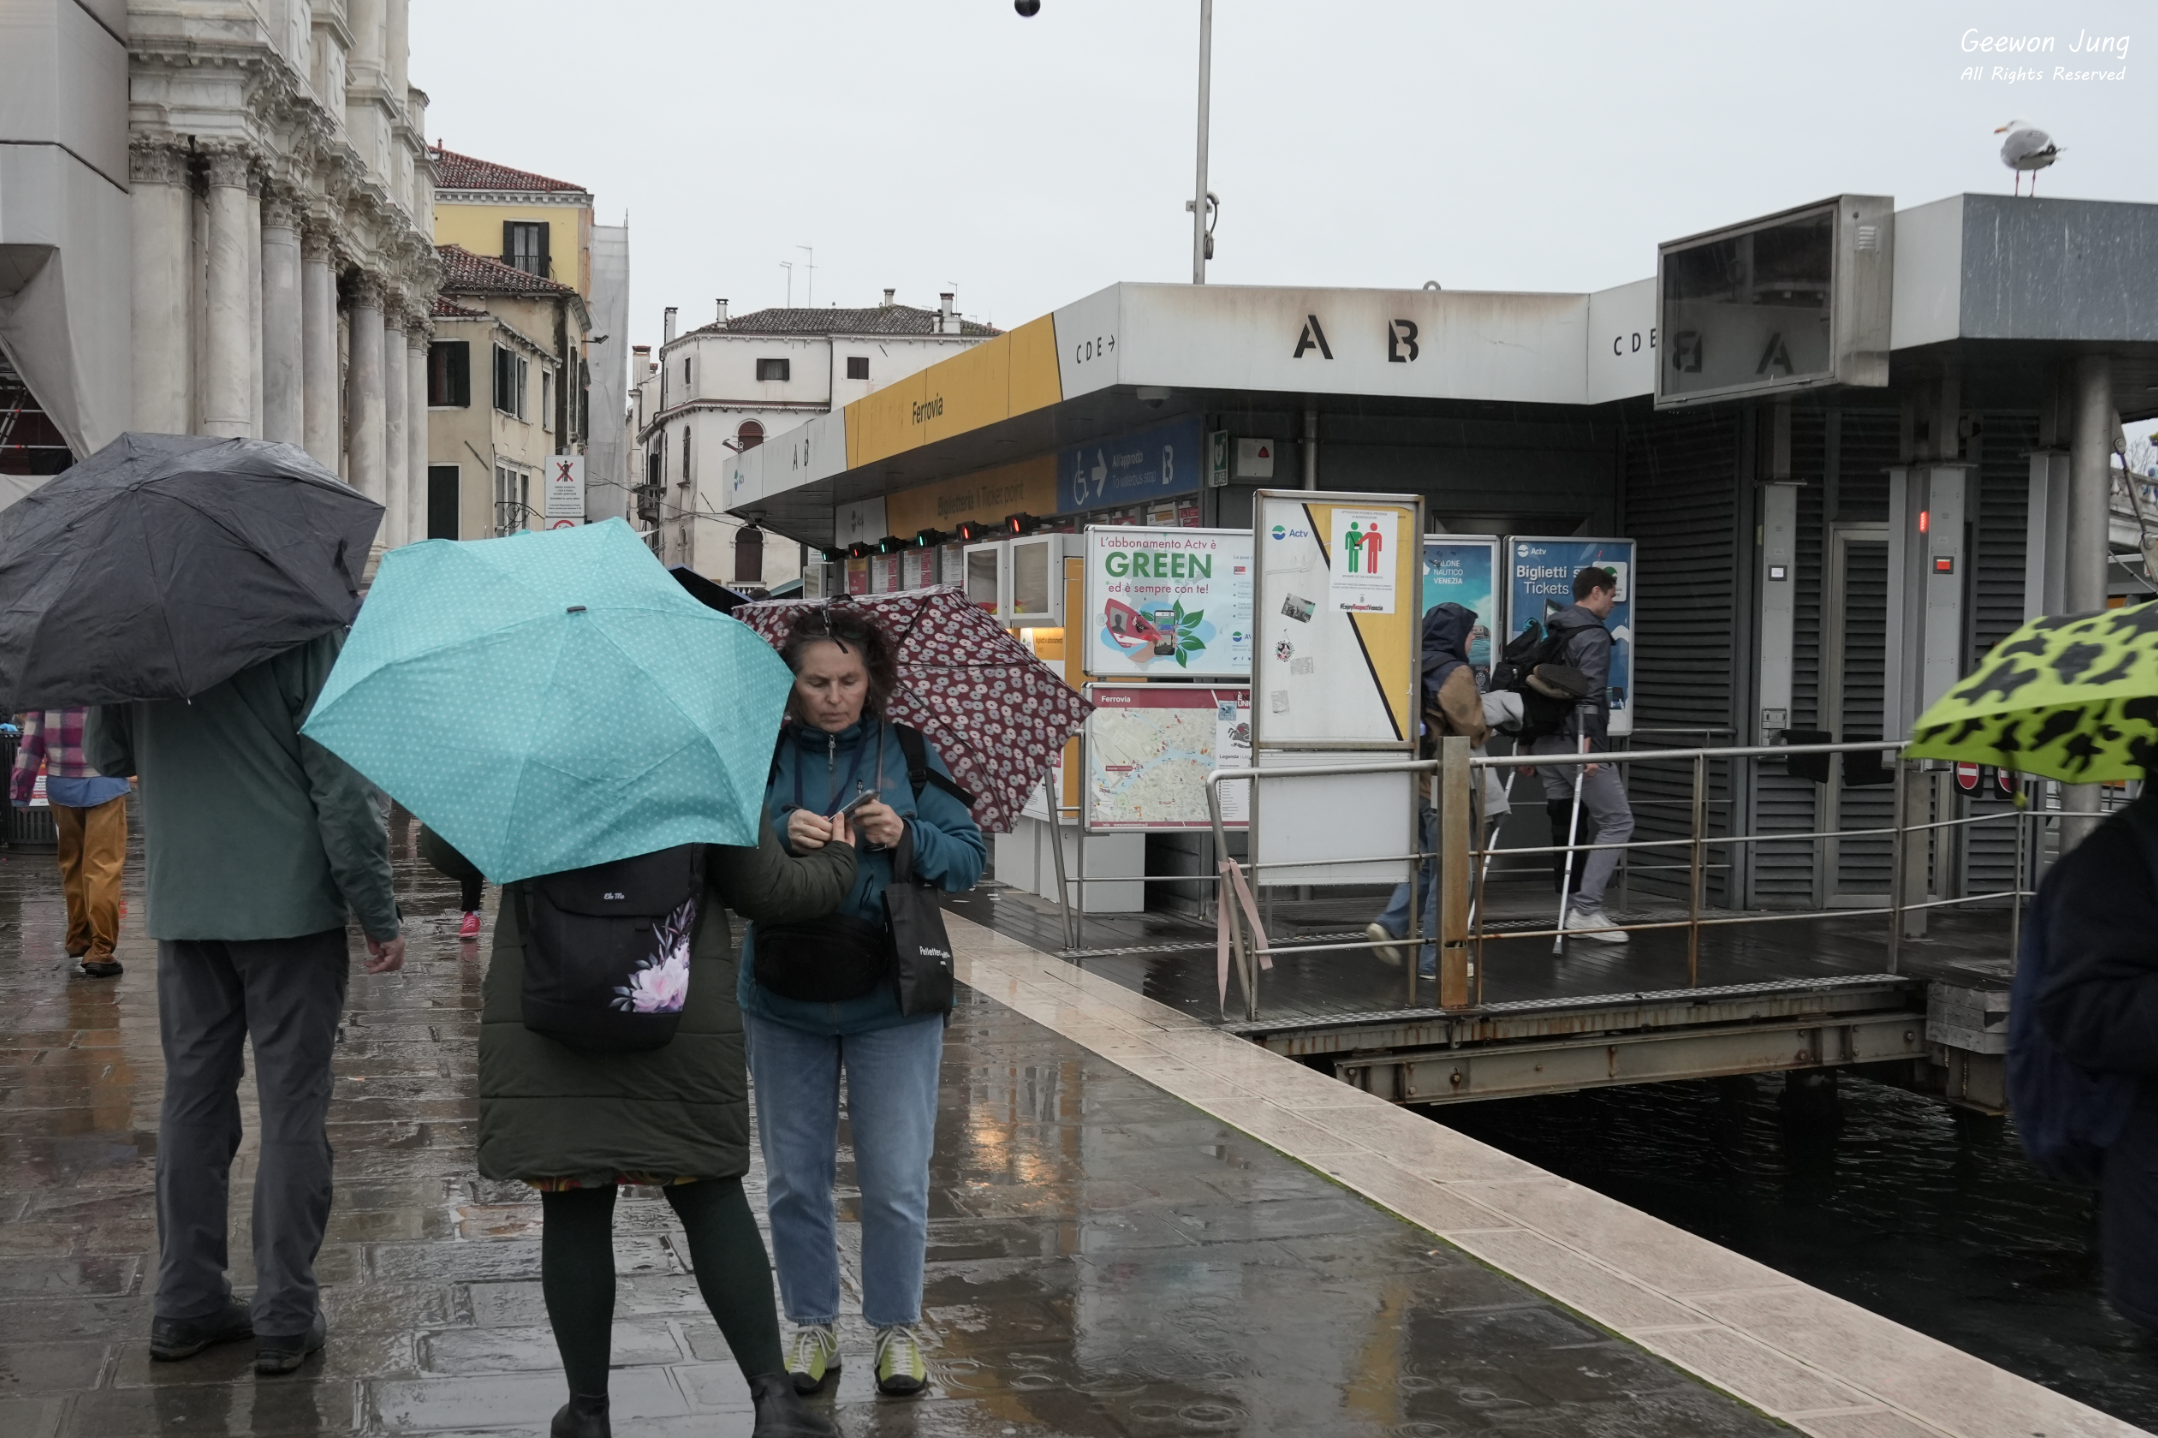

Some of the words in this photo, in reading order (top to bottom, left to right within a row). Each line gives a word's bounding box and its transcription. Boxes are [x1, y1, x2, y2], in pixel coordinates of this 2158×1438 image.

[1293, 314, 1334, 360] A
[1388, 319, 1419, 363] B
[1613, 336, 1622, 356] C
[1632, 332, 1641, 353] D
[1076, 344, 1082, 364] C
[1086, 340, 1092, 361] D
[1097, 336, 1102, 357] E
[912, 392, 943, 425] Ferrovia
[792, 443, 798, 471] A
[1162, 444, 1174, 485] B
[1100, 537, 1182, 549] L'abbonamento
[1184, 539, 1208, 550] Actv
[1210, 540, 1217, 550] è
[1289, 529, 1309, 538] Actv
[1530, 547, 1547, 555] Actv
[1105, 551, 1212, 578] GREEN
[1516, 565, 1567, 581] Biglietti
[1108, 582, 1122, 592] ed
[1125, 583, 1131, 593] è
[1134, 584, 1172, 596] sempre
[1175, 585, 1193, 594] con
[1196, 584, 1209, 594] te!
[1523, 581, 1570, 595] Tickets
[1101, 695, 1131, 703] Ferrovia
